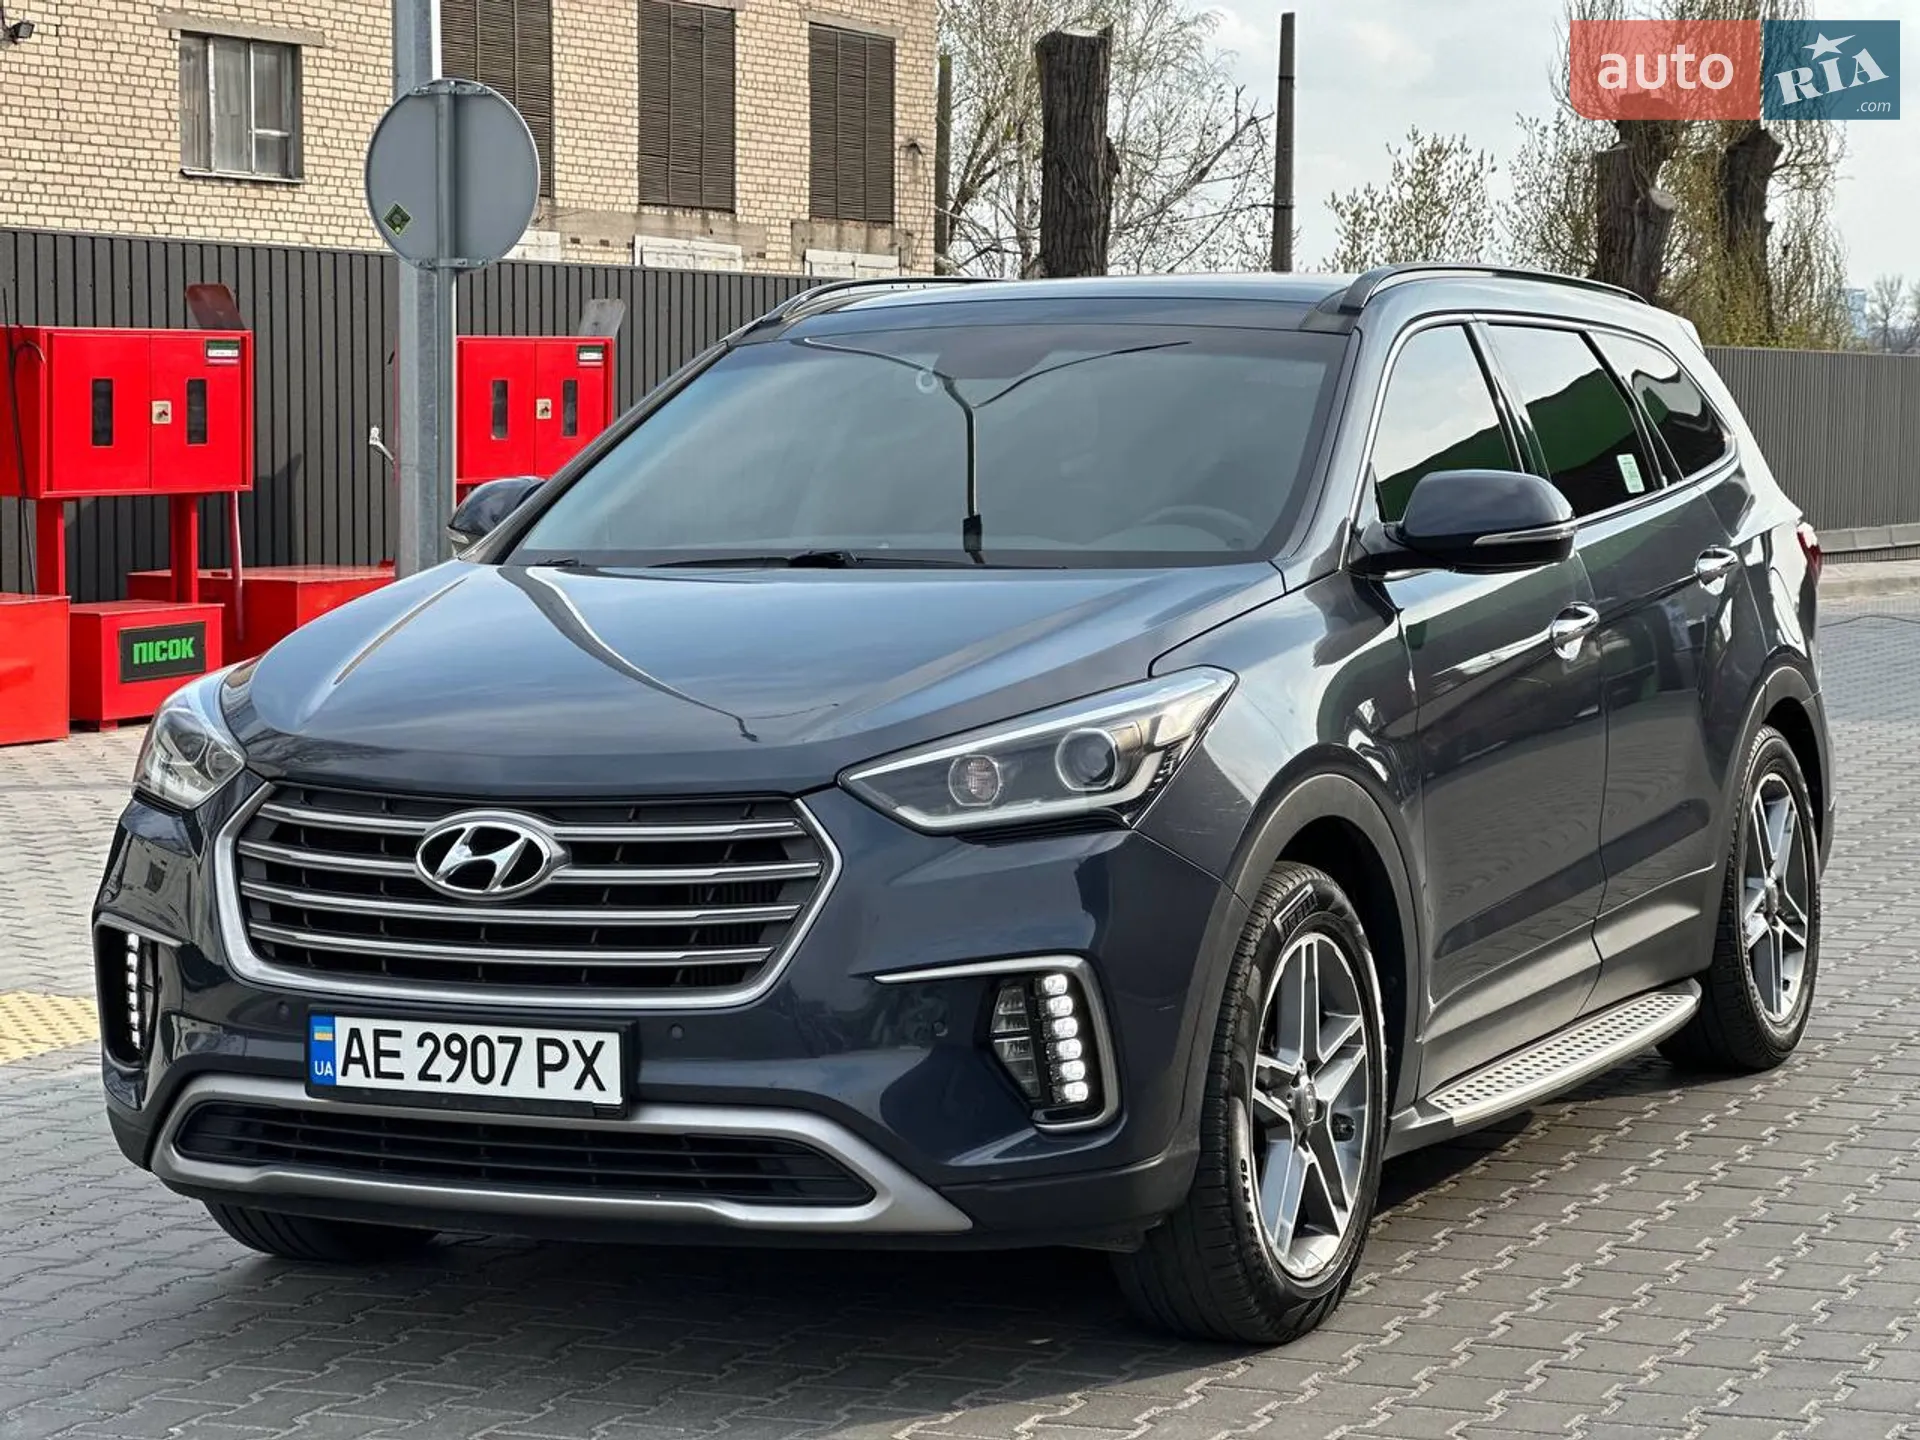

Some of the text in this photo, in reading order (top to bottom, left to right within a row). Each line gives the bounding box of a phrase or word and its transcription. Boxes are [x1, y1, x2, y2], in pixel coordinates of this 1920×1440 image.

[133, 637, 195, 665] ПІСОК
[314, 1060, 334, 1077] UA
[340, 1027, 606, 1092] AE 2907 PX
